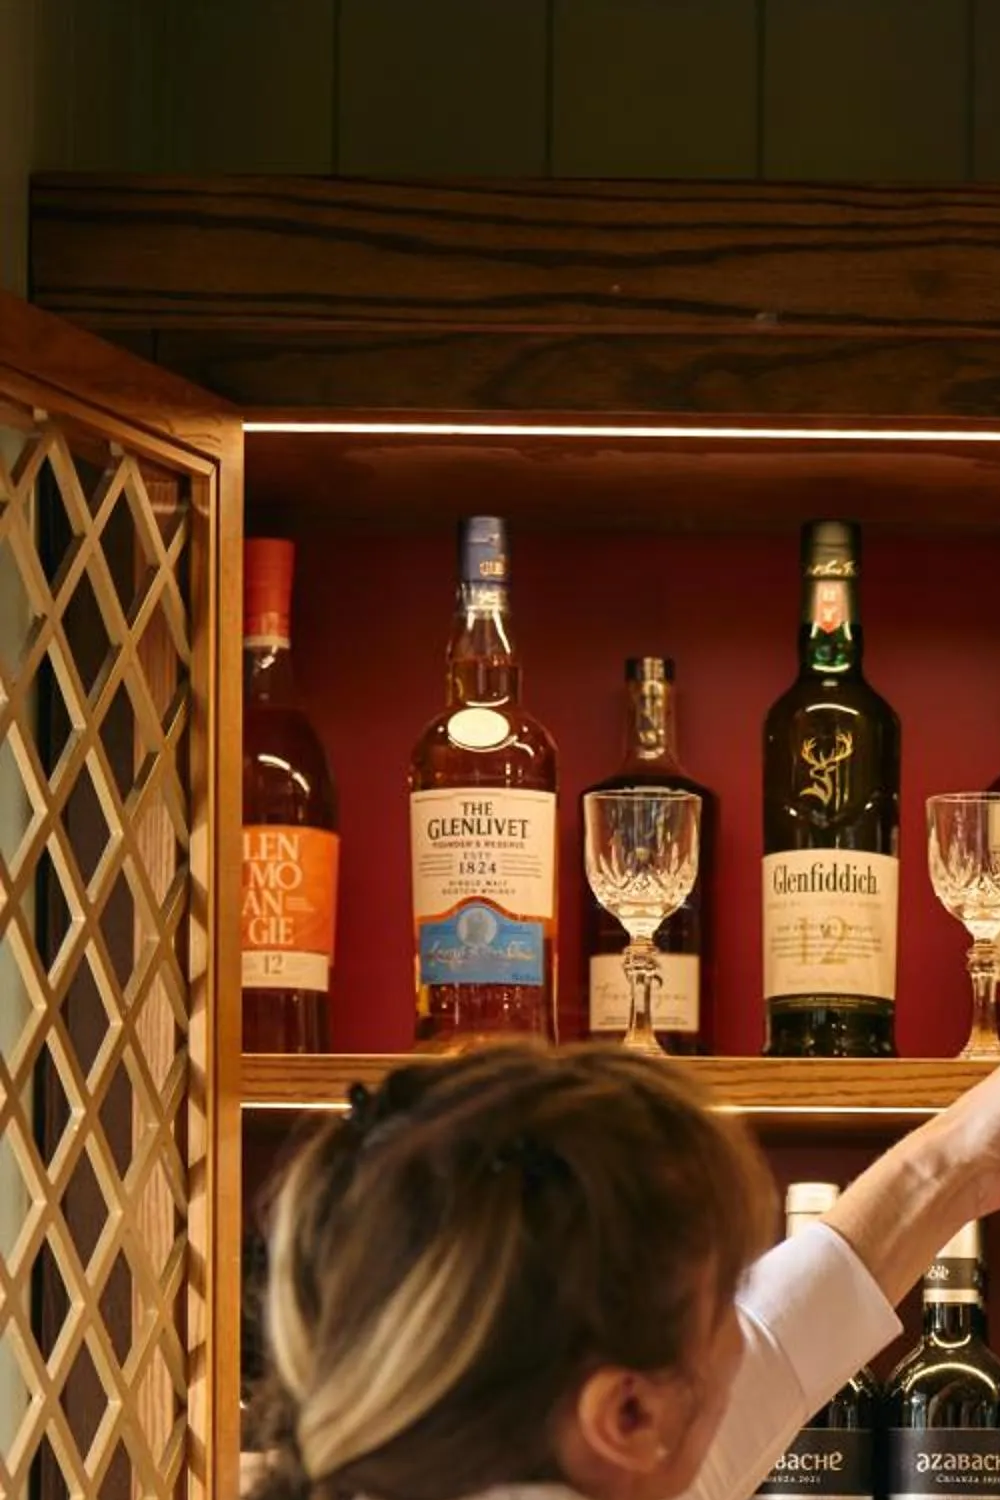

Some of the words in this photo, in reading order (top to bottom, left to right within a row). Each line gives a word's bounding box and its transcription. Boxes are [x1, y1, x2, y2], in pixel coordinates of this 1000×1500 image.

[460, 801, 494, 816] THE
[427, 817, 529, 841] GLENLIVET
[243, 832, 299, 861] LEN
[458, 861, 497, 875] 1824
[773, 861, 877, 895] Glenfiddich
[242, 889, 284, 916] AN
[263, 954, 284, 976] 12
